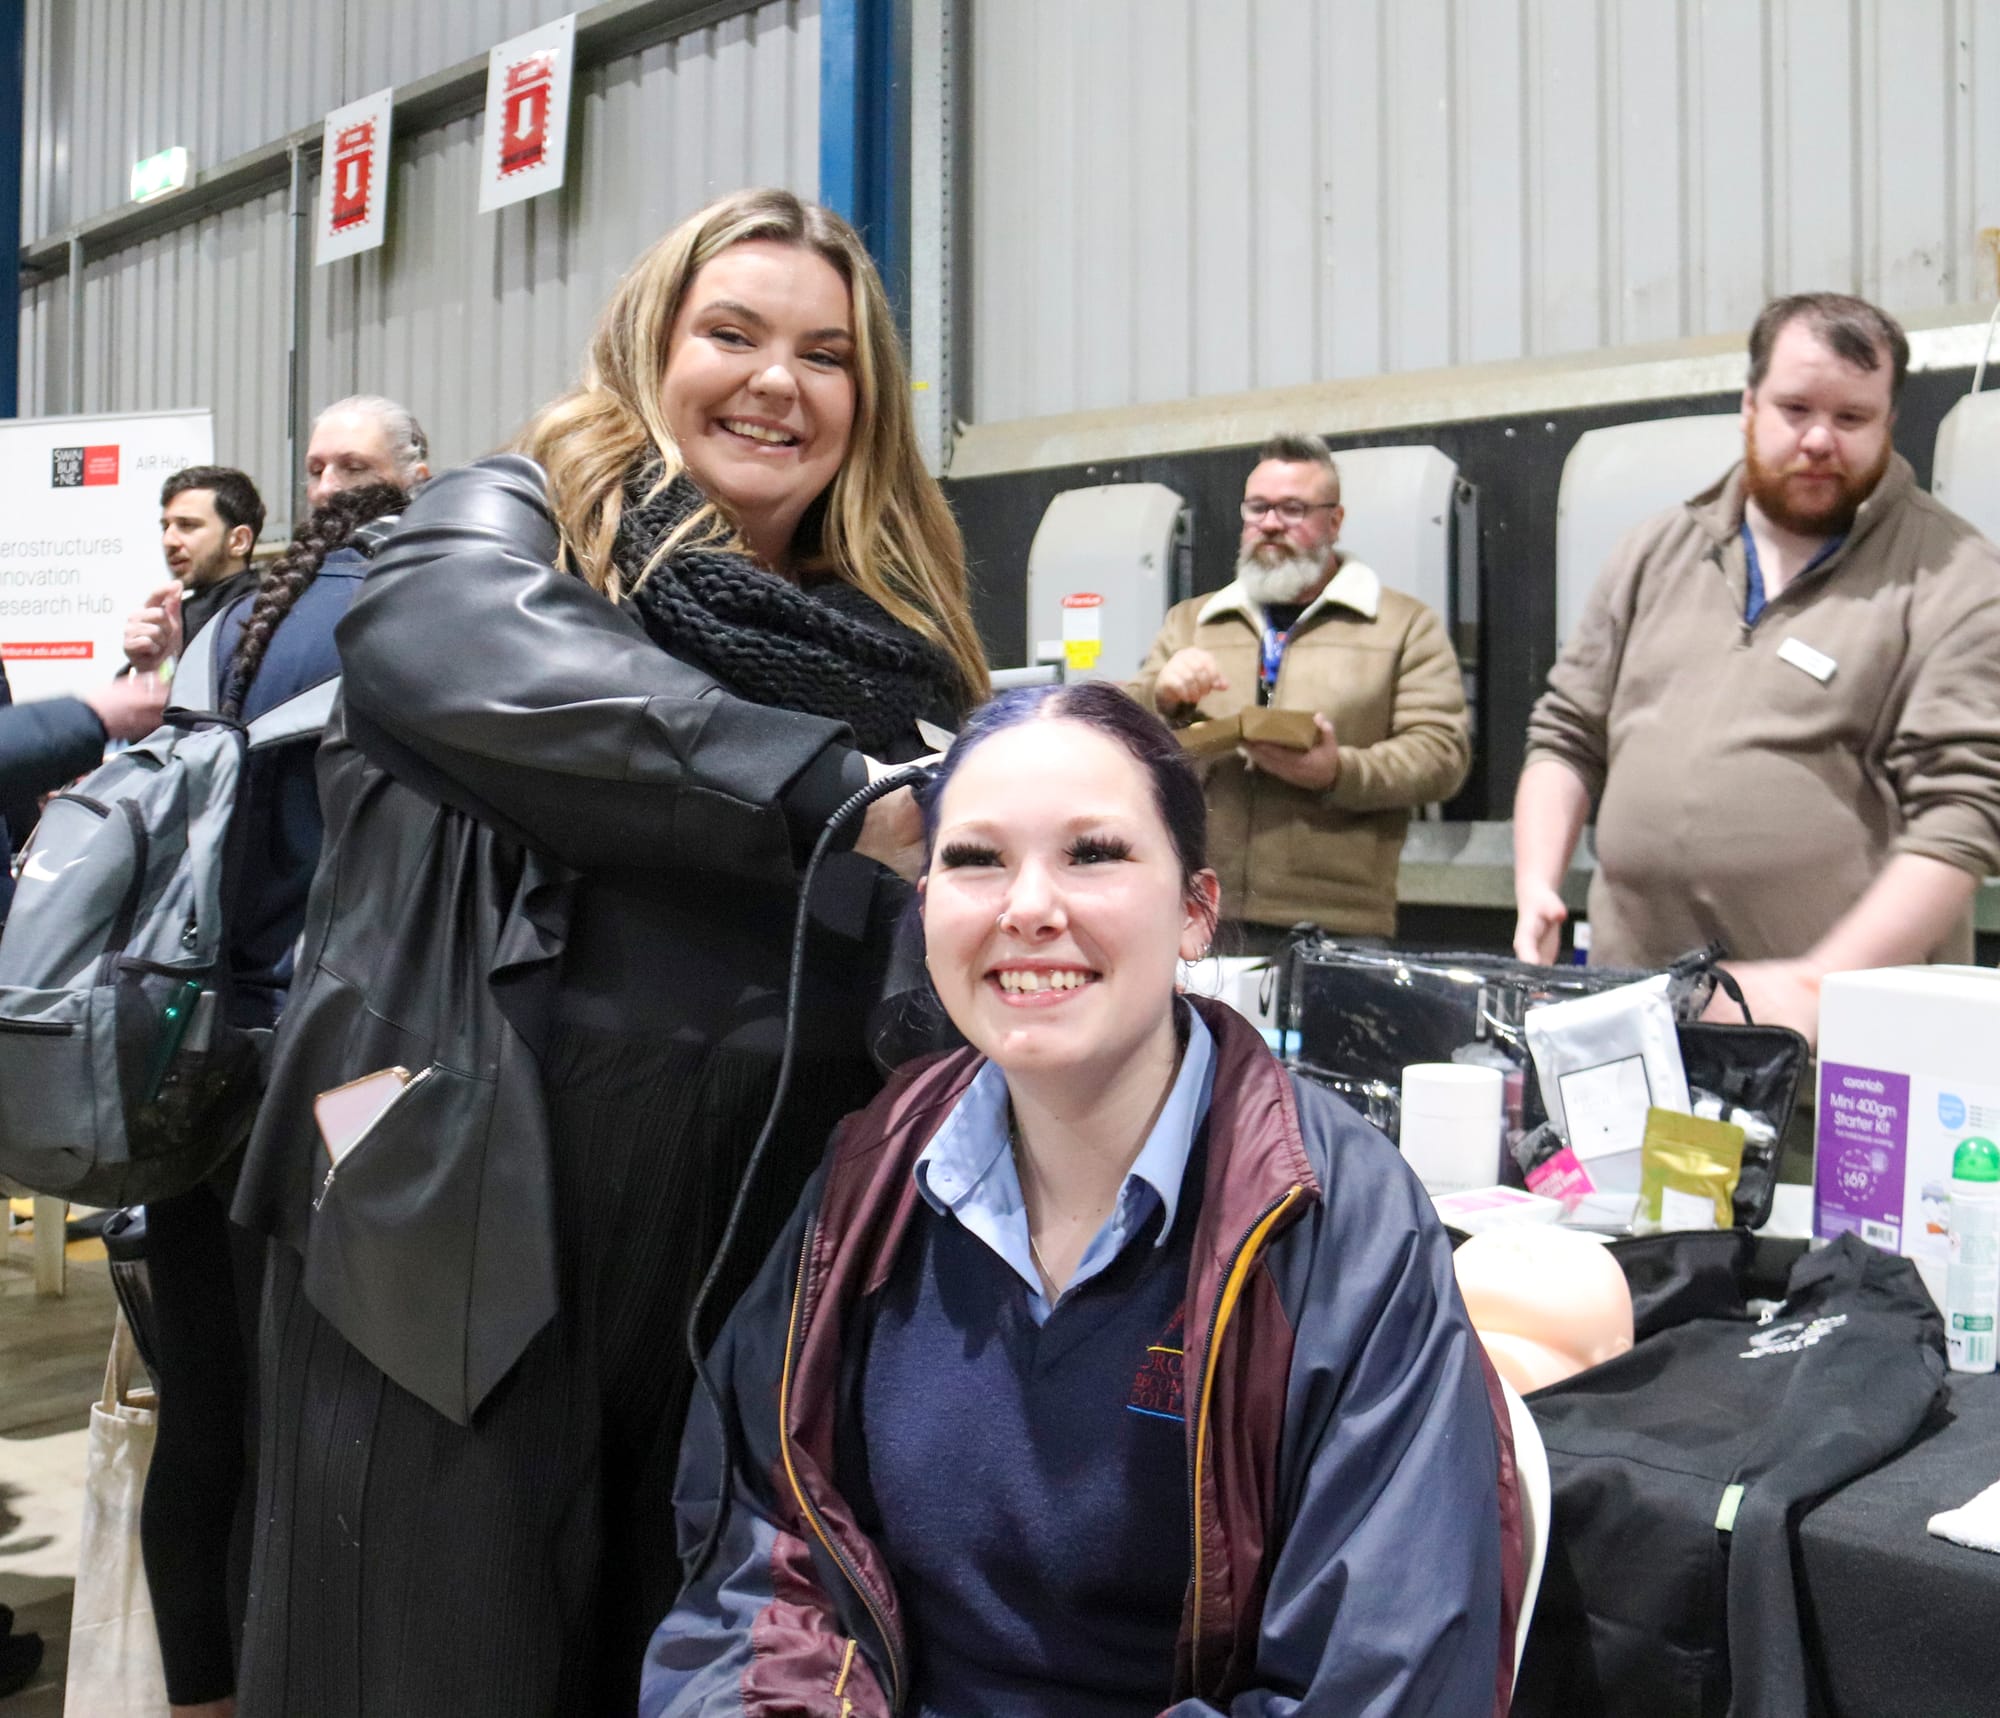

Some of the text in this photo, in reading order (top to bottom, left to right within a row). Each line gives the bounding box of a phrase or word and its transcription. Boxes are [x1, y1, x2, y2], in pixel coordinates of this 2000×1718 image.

[136, 455, 188, 470] AIR Hub
[78, 593, 113, 614] Hub
[1830, 1092, 1898, 1119] Mini 400gm
[1834, 1110, 1891, 1136] Starter Kit
[1843, 1170, 1868, 1189] $69
